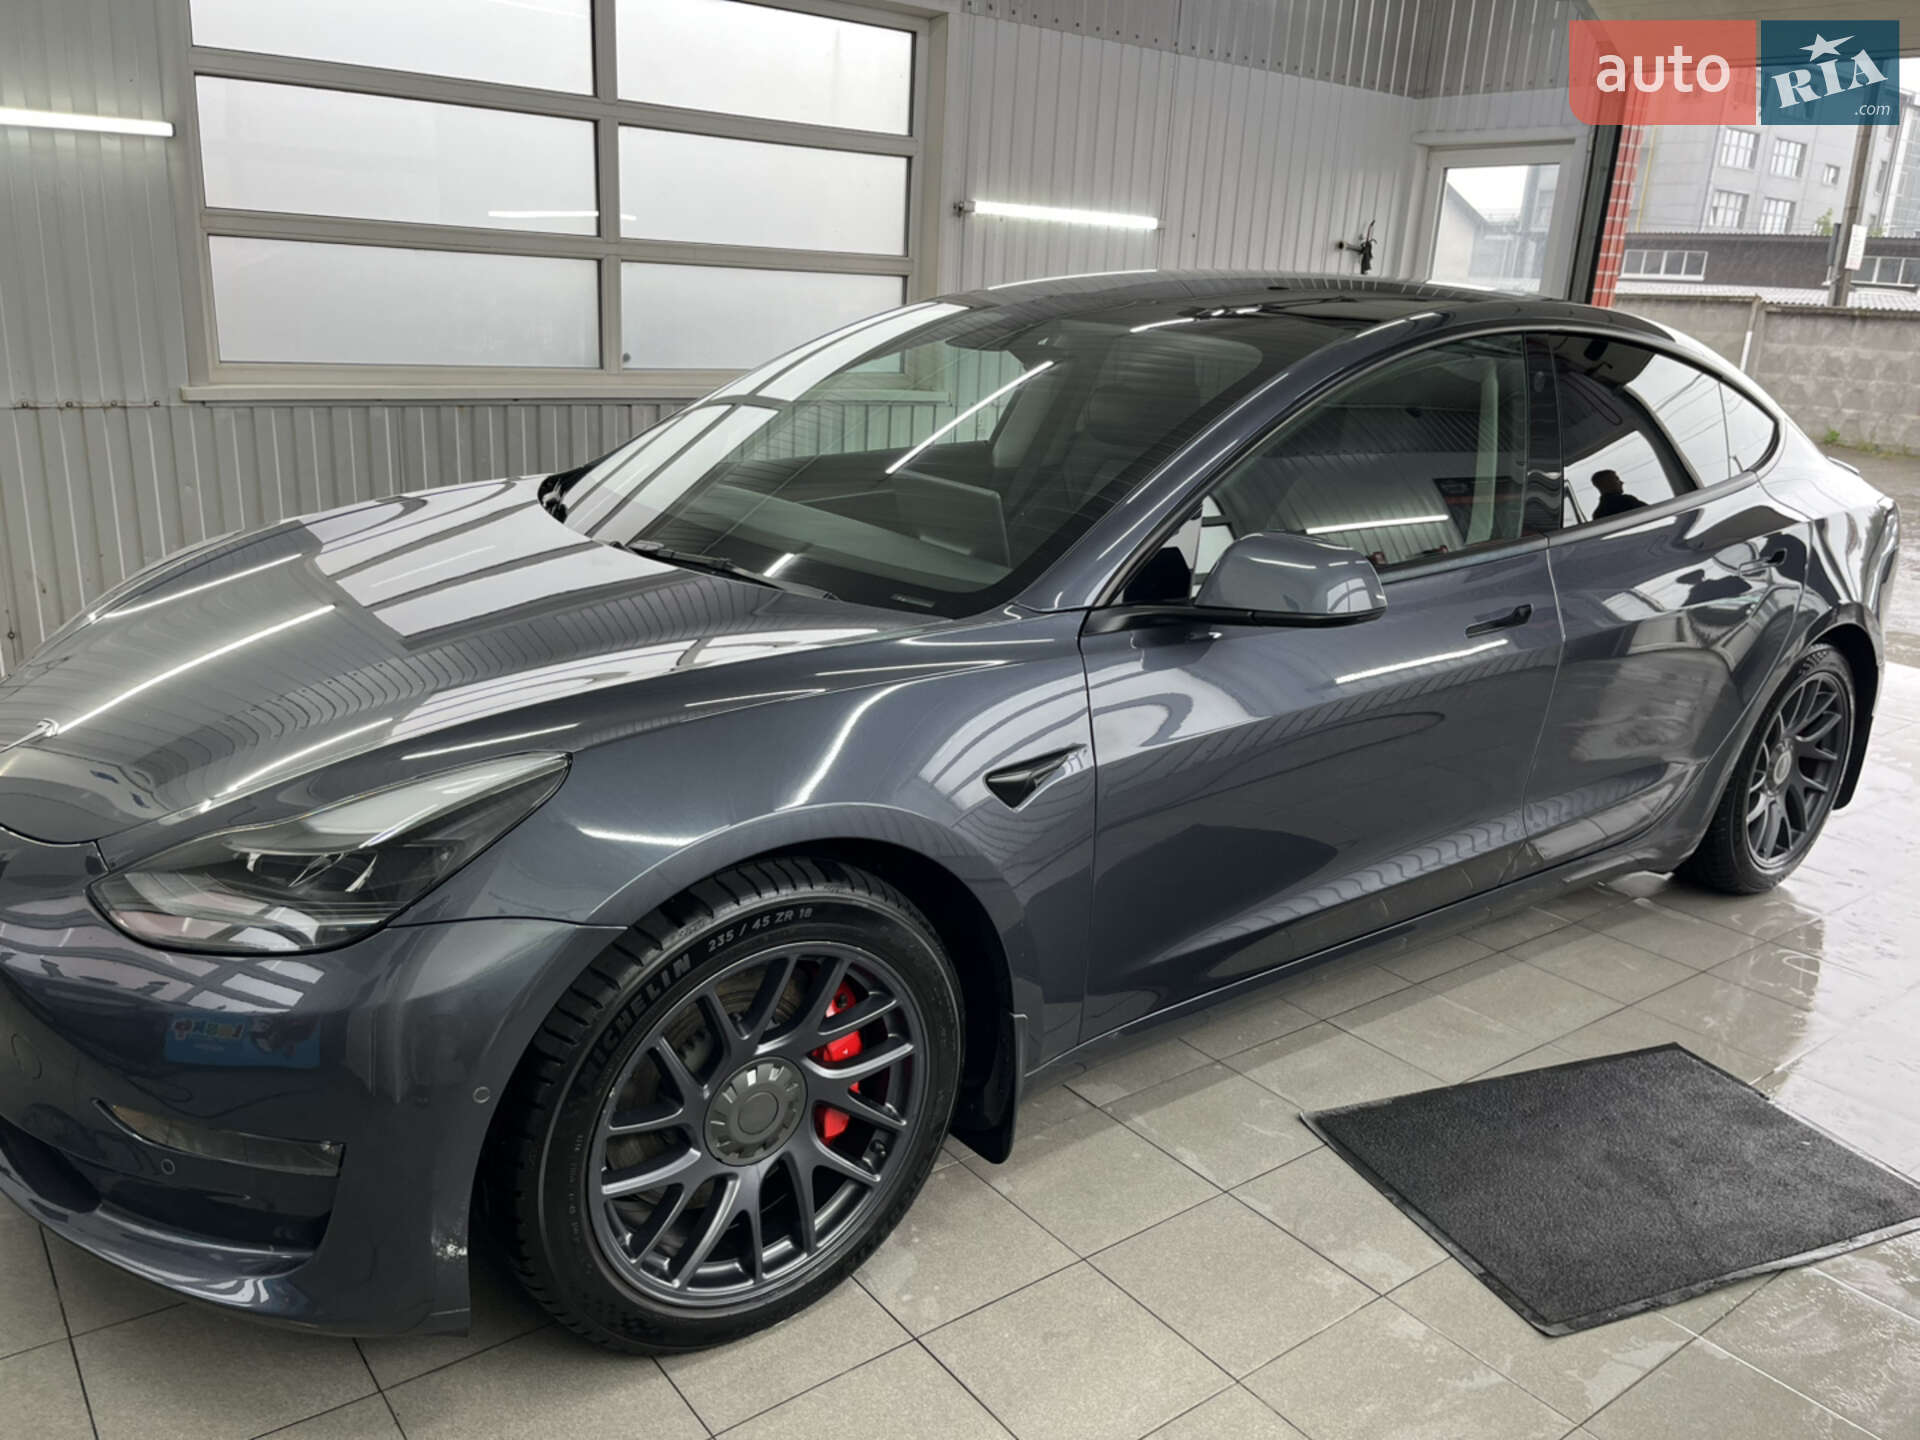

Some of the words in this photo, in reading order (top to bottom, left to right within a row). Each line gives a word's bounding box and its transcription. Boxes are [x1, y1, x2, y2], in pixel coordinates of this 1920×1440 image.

[708, 930, 735, 952] 235
[752, 915, 771, 930] 45
[774, 910, 794, 924] ZR
